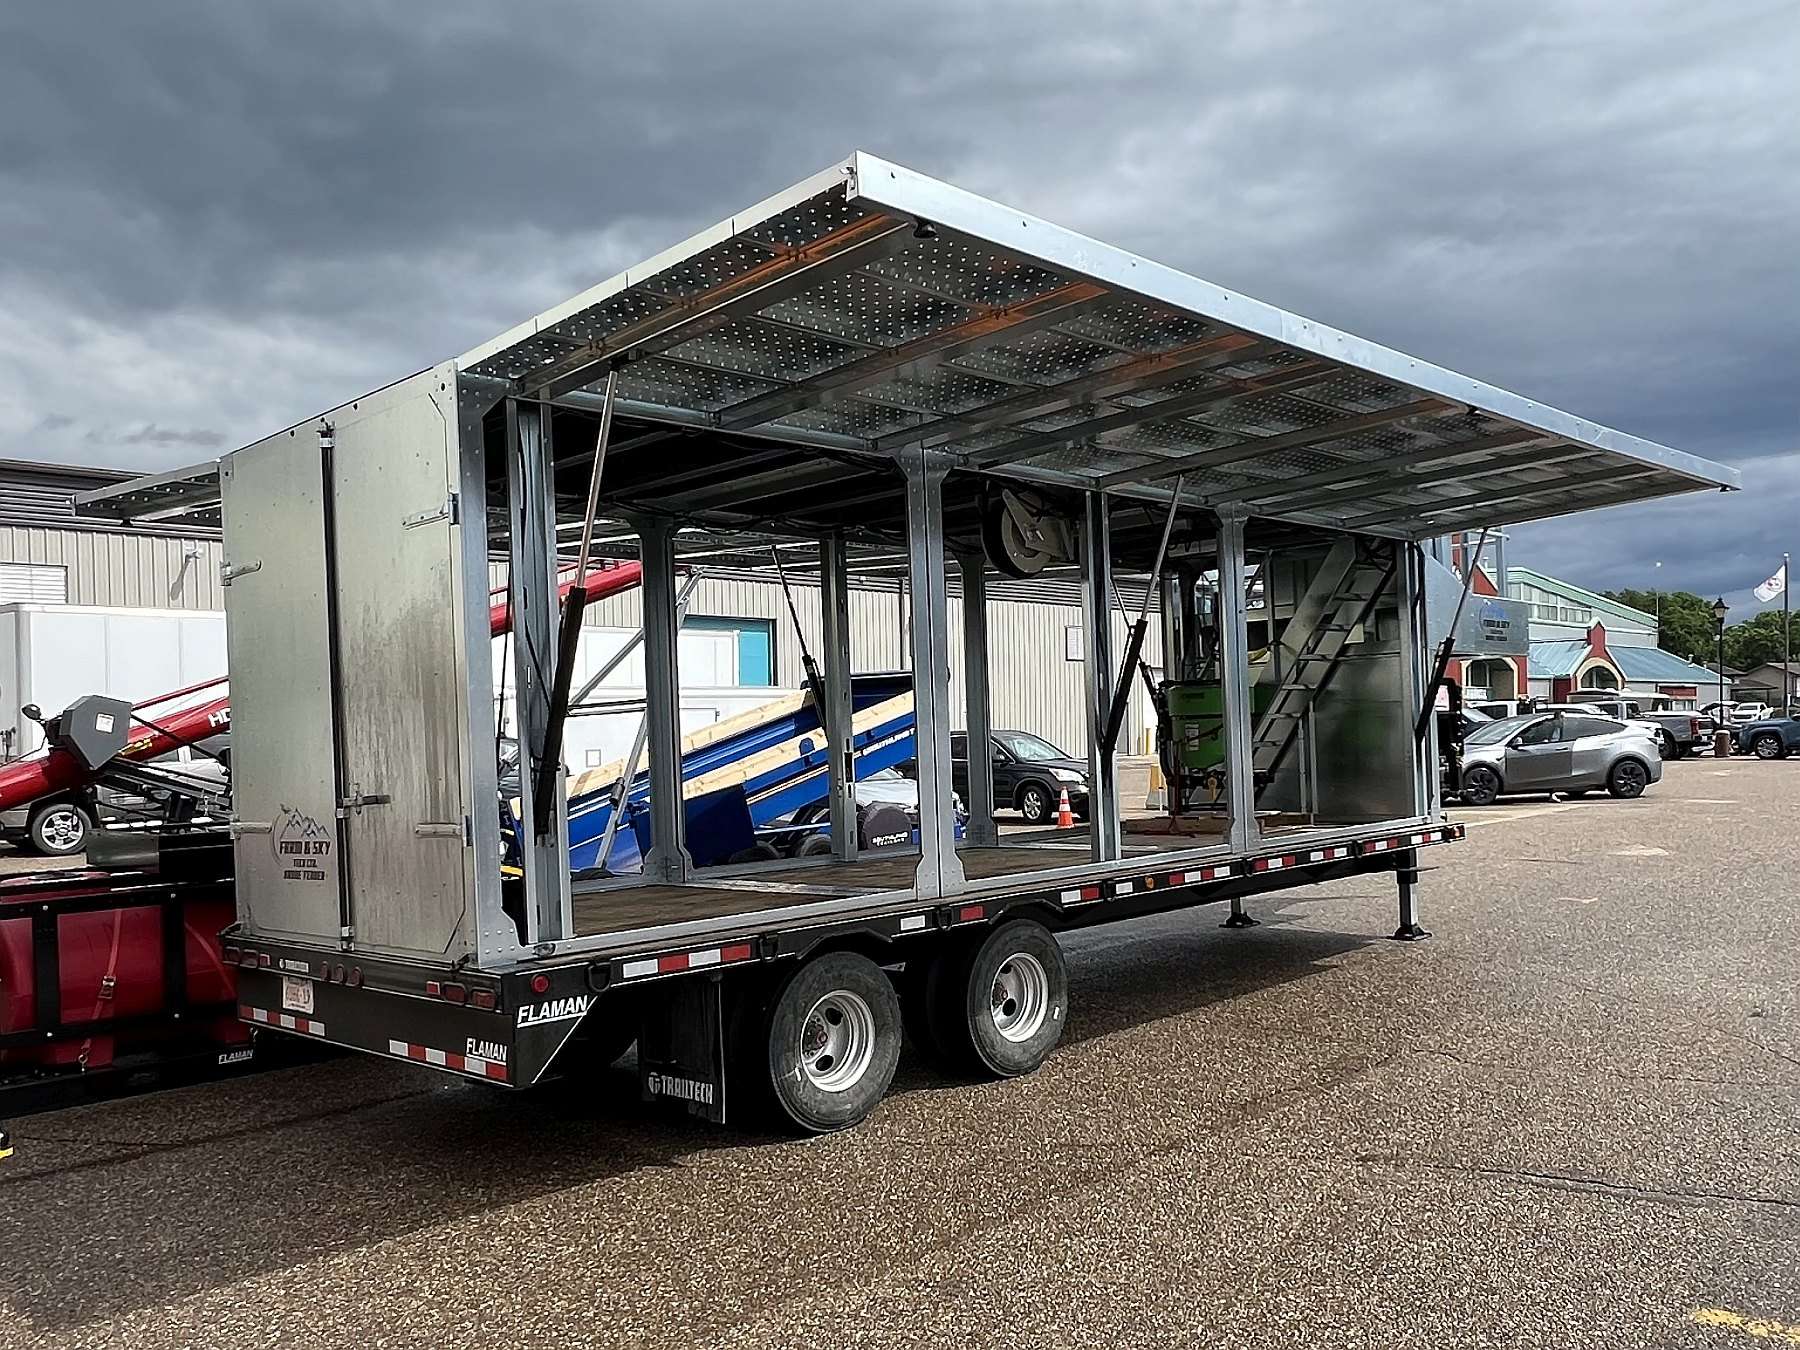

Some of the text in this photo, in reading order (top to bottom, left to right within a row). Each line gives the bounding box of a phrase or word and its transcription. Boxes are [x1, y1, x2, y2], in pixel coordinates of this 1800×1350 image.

[312, 841, 331, 855] SKY
[517, 994, 588, 1024] FLAMAN
[466, 1037, 507, 1061] FLAMAN
[660, 1075, 713, 1105] TRAILTECH
